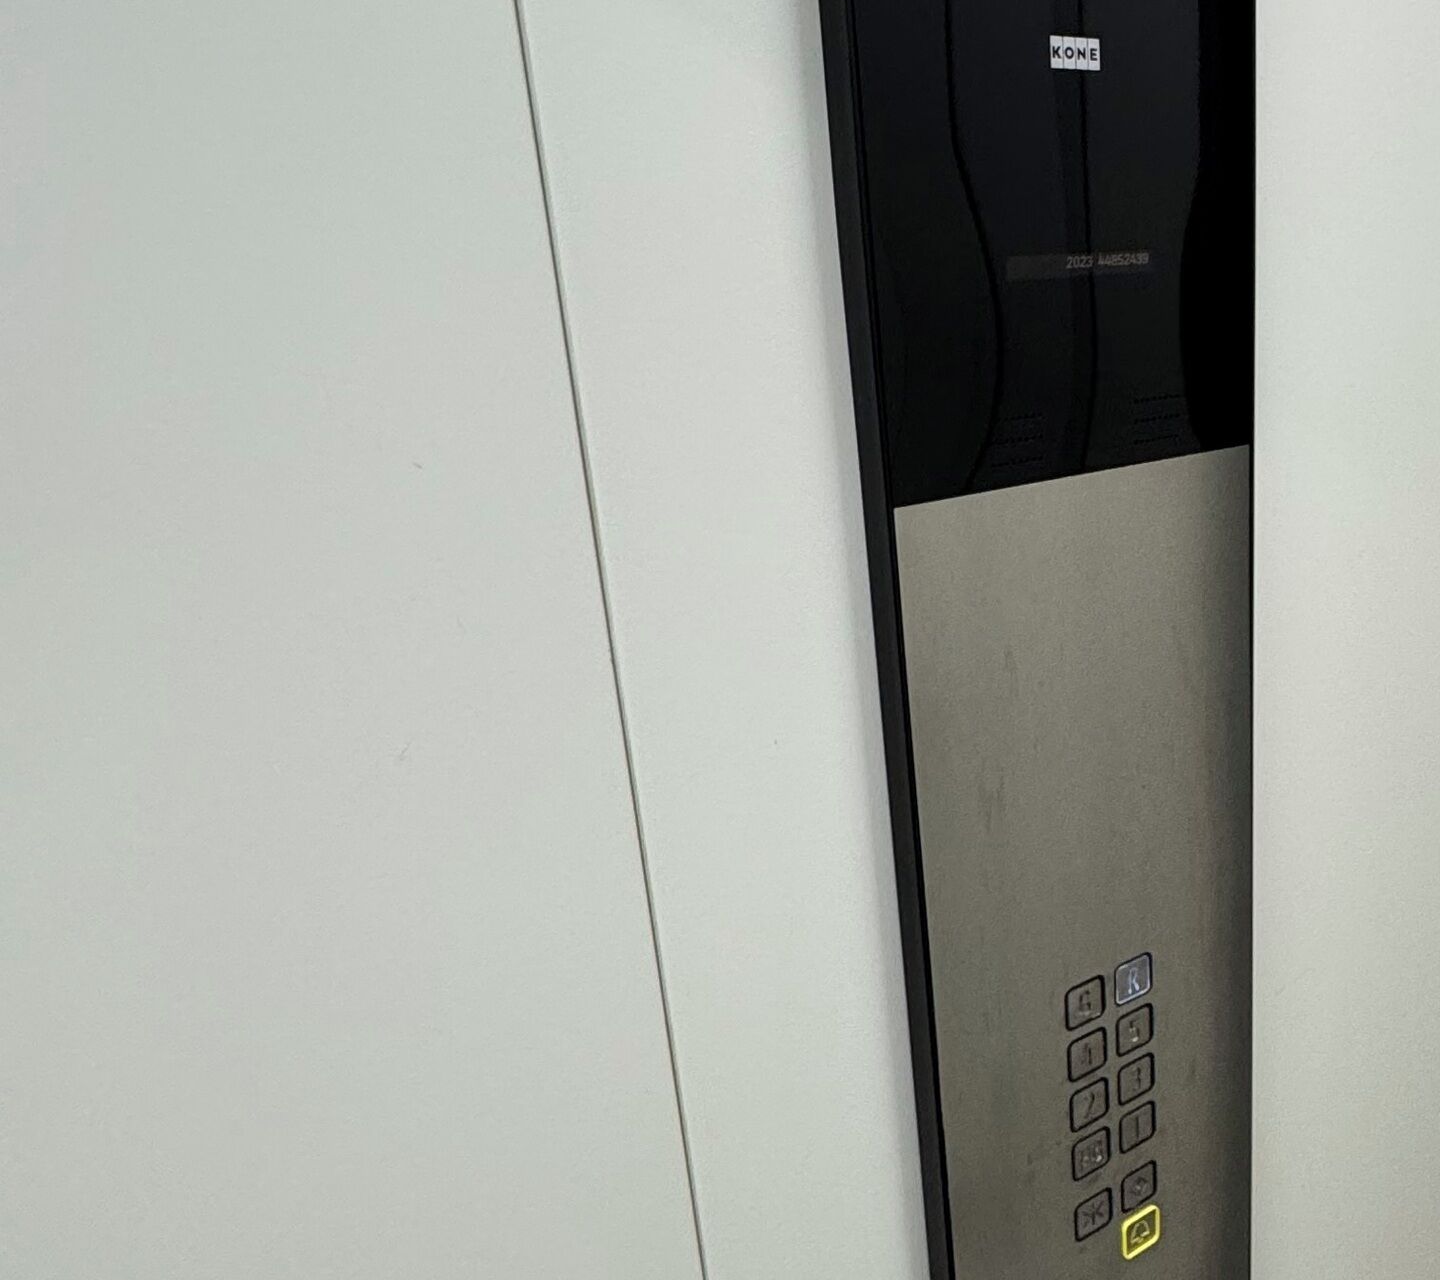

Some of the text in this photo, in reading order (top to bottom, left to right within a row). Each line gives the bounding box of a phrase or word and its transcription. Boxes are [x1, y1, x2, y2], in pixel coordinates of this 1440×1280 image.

[1051, 45, 1098, 61] KONE
[1065, 255, 1094, 269] 2023
[1127, 966, 1141, 996] R
[1128, 1019, 1141, 1044] 5
